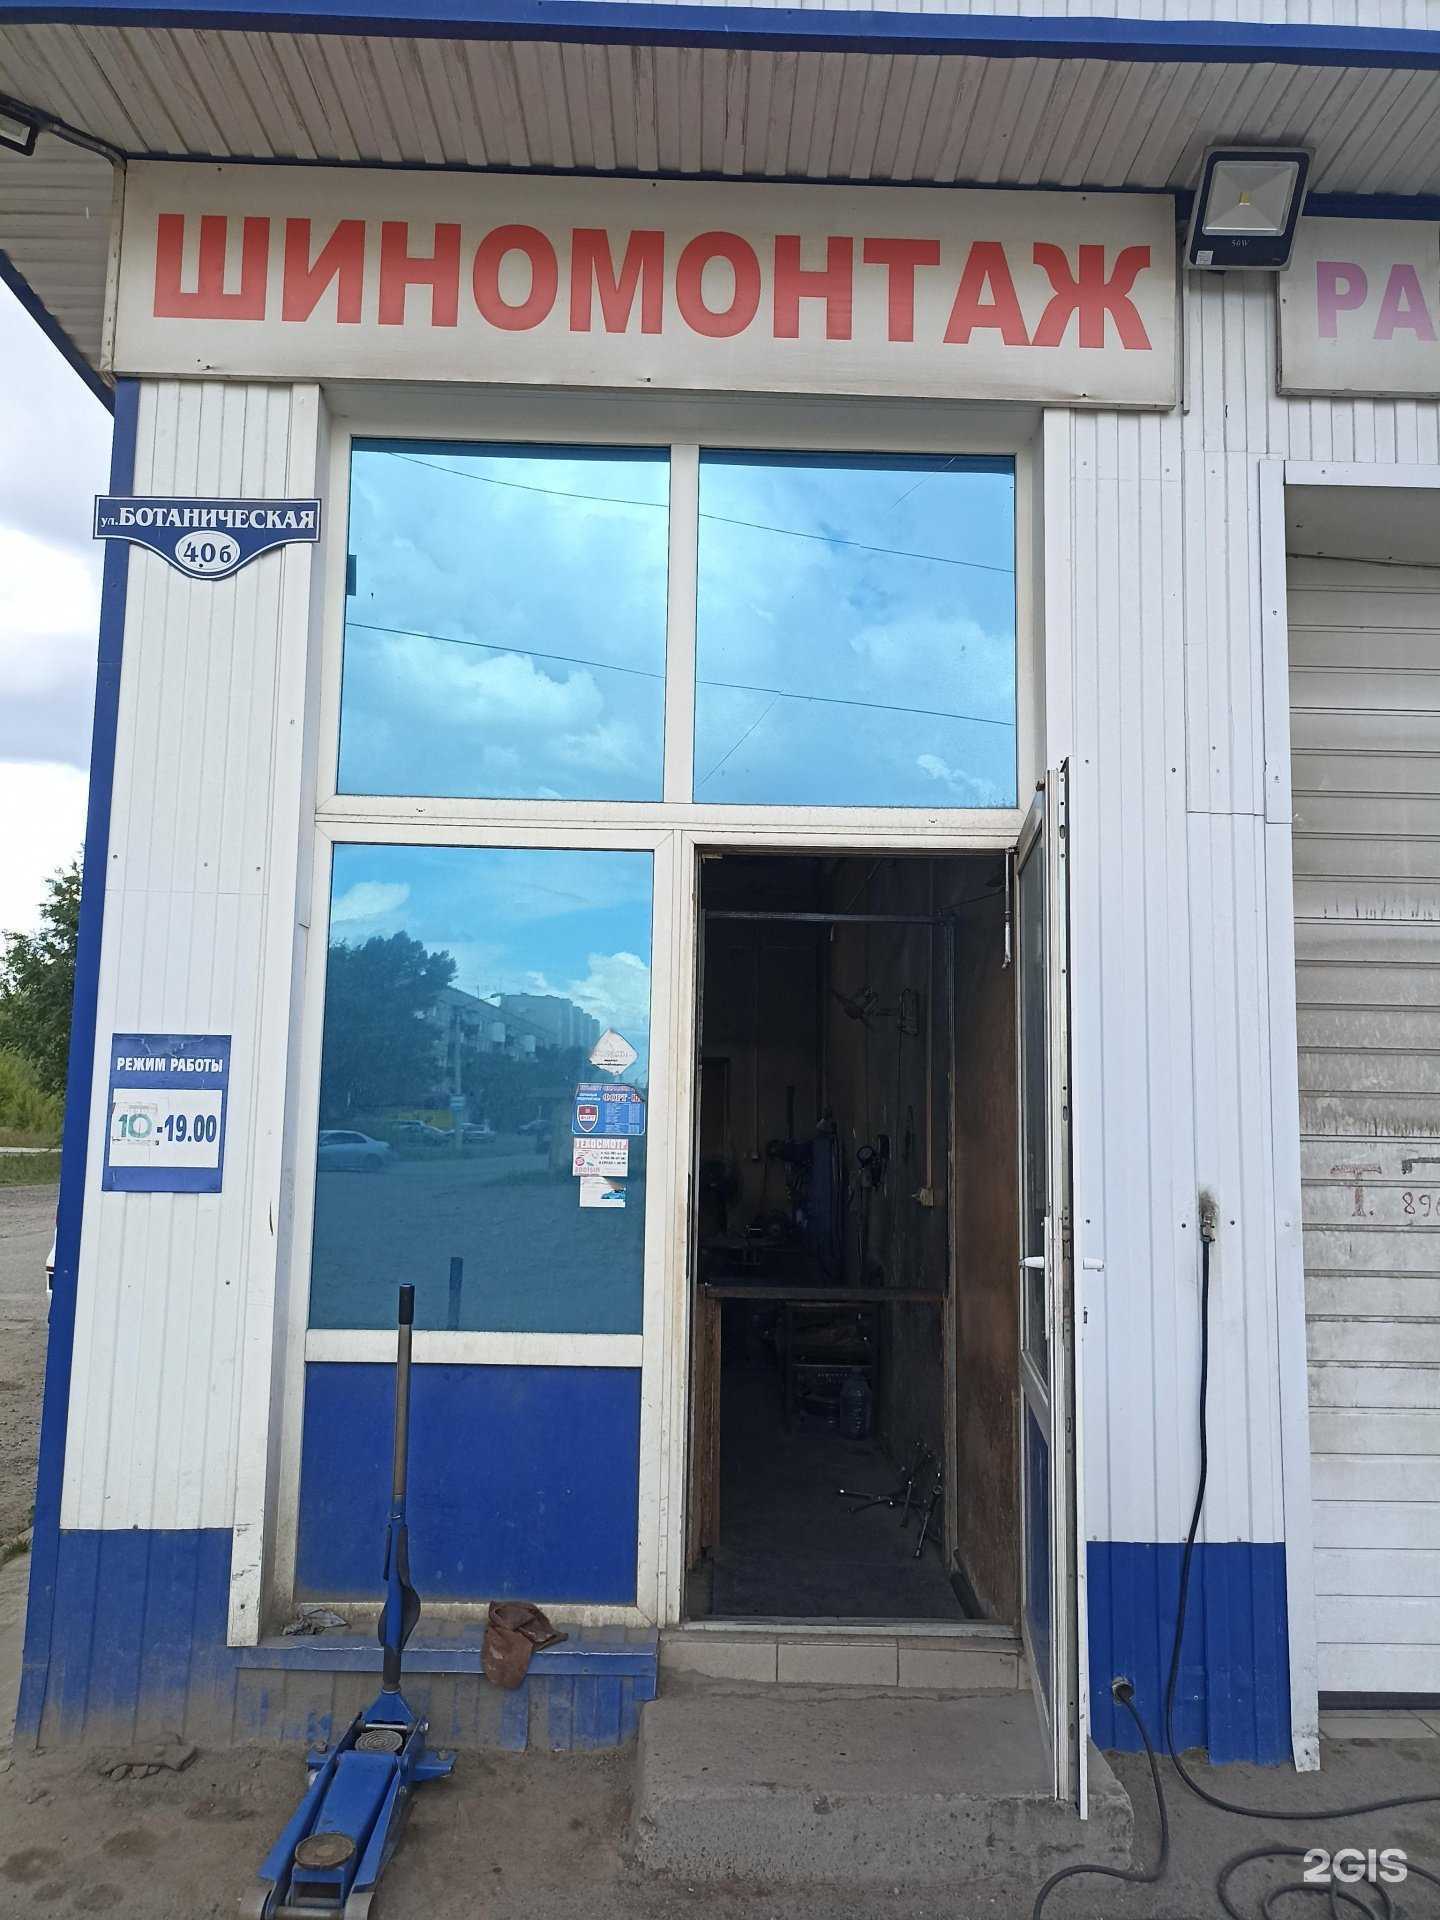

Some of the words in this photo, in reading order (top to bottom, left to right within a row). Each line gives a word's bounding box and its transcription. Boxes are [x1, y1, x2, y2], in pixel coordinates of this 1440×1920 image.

[153, 213, 1152, 351] ШИНОМОНТАЖ
[101, 516, 119, 526] ул.
[119, 507, 315, 529] БОТАНИЧЕСКАЯ
[116, 1057, 166, 1071] РЕЖИМ
[170, 1058, 223, 1073] РАБОТЫ
